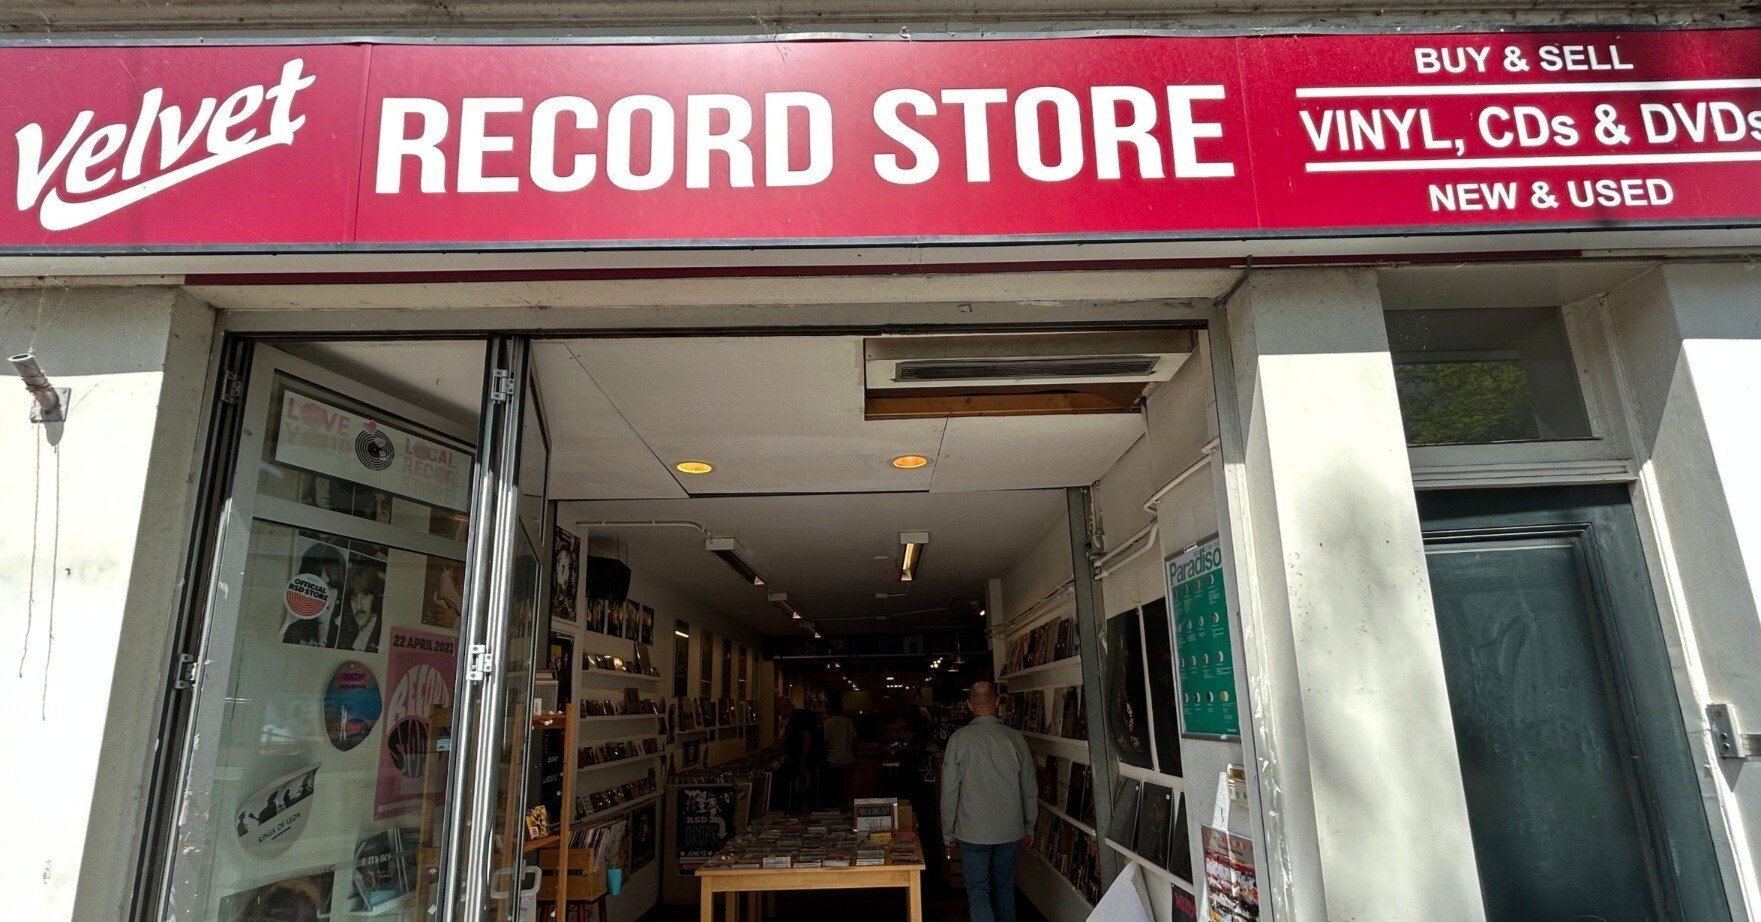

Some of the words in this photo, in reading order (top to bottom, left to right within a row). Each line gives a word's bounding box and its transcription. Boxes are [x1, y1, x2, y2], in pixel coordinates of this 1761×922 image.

[1414, 46, 1491, 74] BUY
[1503, 45, 1530, 72] &
[1539, 44, 1634, 72] SELL
[15, 57, 316, 231] Velvet
[376, 90, 833, 194] RECORD
[873, 83, 1235, 185] STORE
[1299, 108, 1466, 157] VINYL,
[1478, 105, 1579, 148] CDs
[1594, 103, 1631, 146] &
[1428, 182, 1518, 212] NEW
[1530, 180, 1559, 209] &
[1567, 178, 1674, 207] USED
[287, 397, 350, 437] LOVE
[404, 437, 456, 470] LOCAL
[1168, 546, 1222, 586] Paradiso
[288, 582, 305, 593] RSD
[304, 589, 329, 602] STORE
[294, 578, 327, 594] OFFICIAL
[393, 634, 406, 647] 22
[407, 636, 433, 651] APRIL
[258, 825, 276, 843] KINGS
[276, 821, 285, 831] OF
[285, 811, 302, 826] LEON
[685, 825, 718, 847] DROPS
